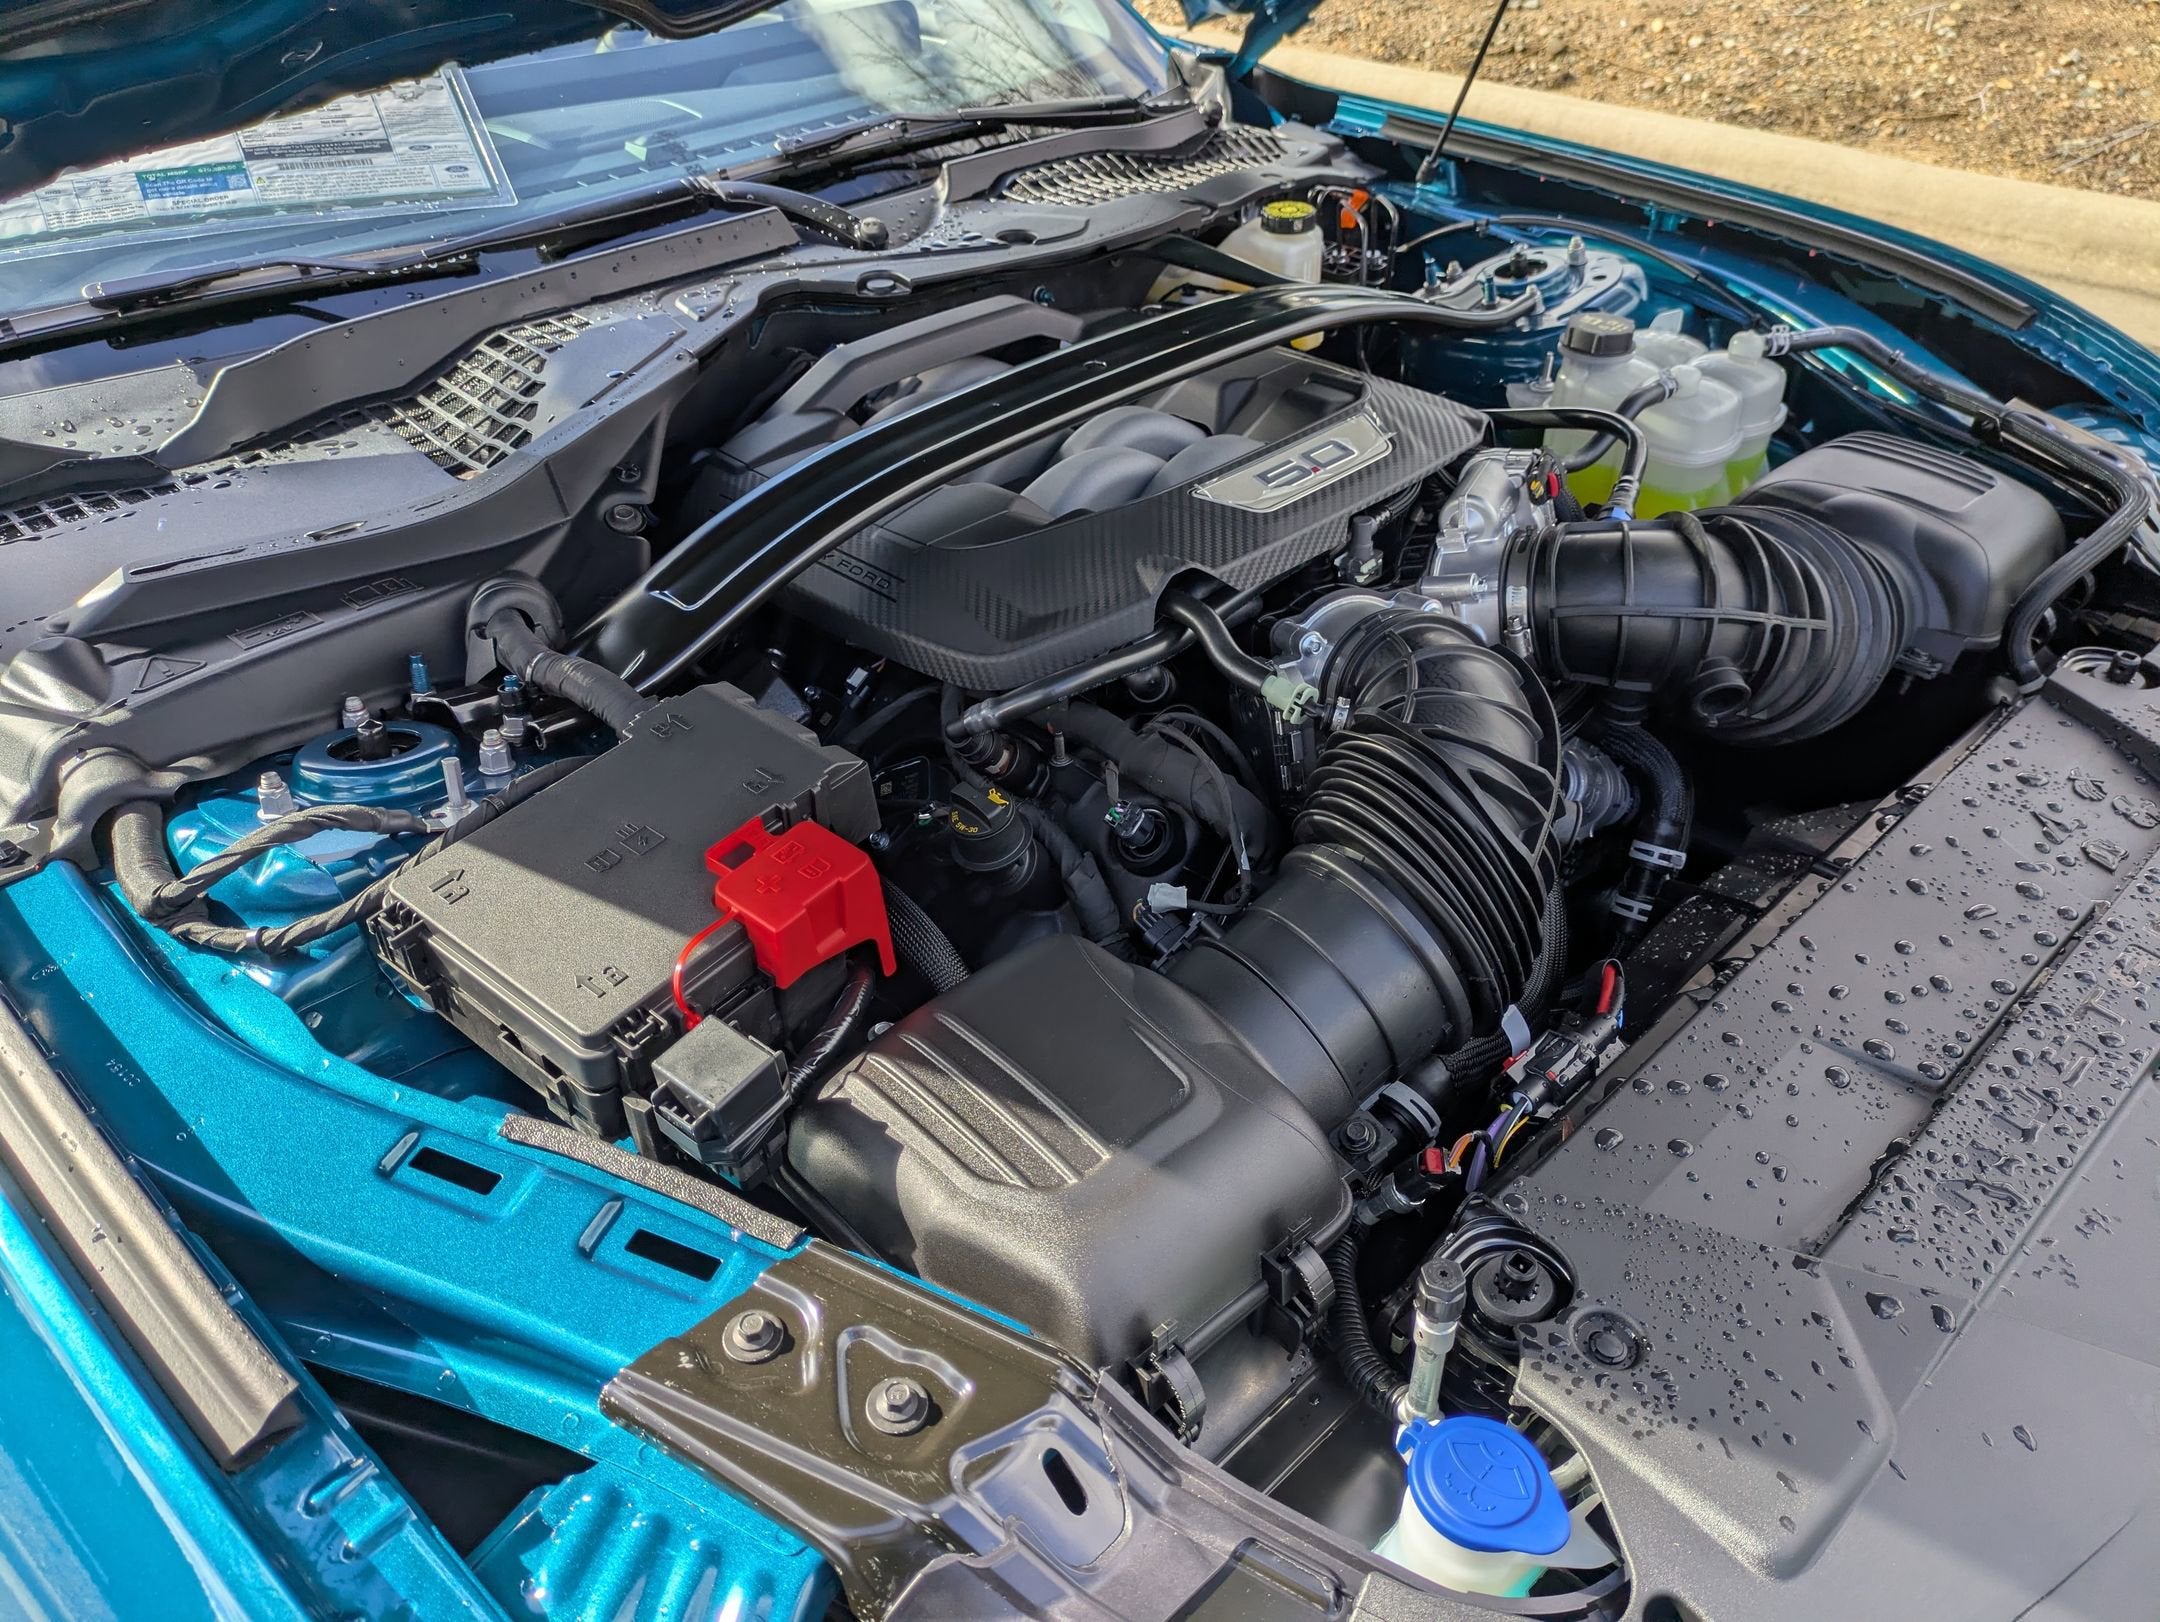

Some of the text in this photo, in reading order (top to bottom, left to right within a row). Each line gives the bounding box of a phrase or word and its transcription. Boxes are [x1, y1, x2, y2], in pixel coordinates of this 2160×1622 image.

[1254, 438, 1359, 489] 5.0
[837, 559, 892, 589] FORD
[955, 821, 979, 833] 5W-30
